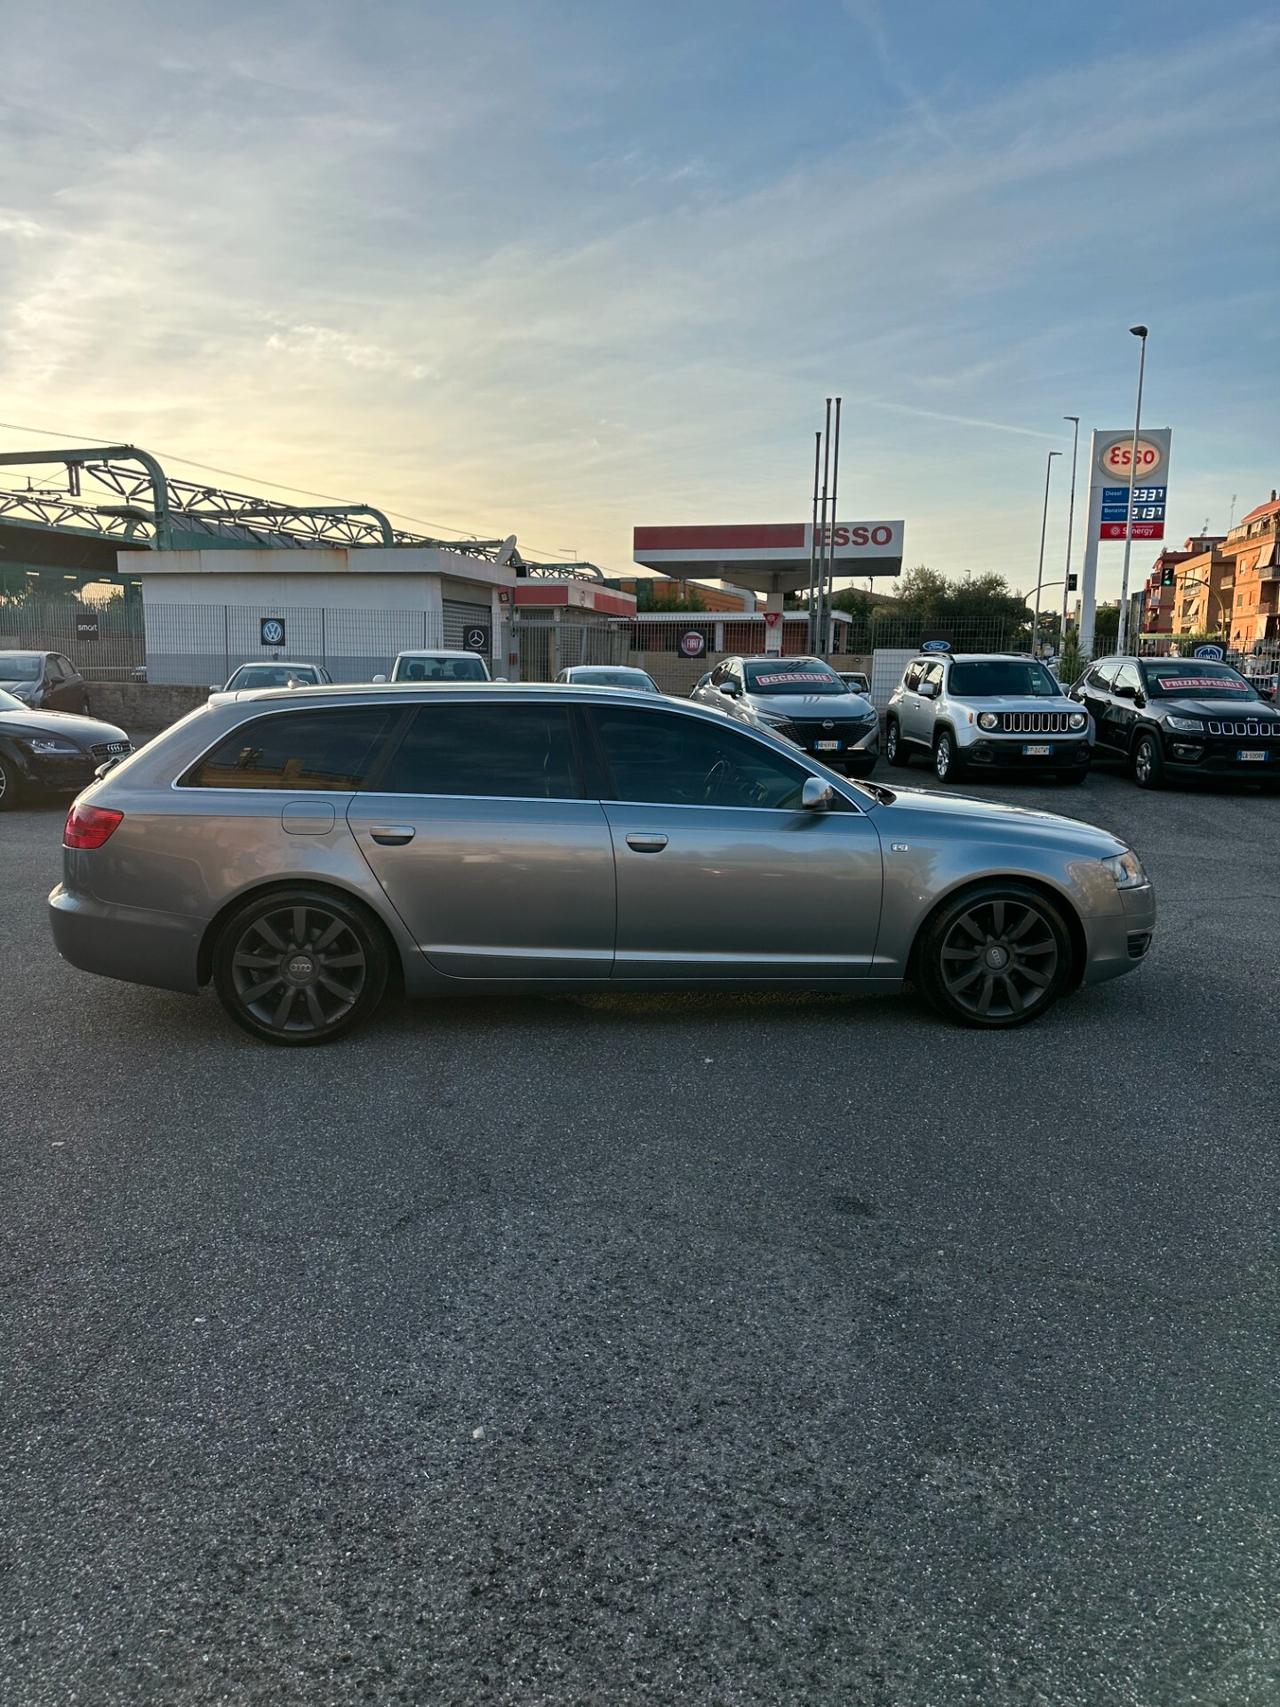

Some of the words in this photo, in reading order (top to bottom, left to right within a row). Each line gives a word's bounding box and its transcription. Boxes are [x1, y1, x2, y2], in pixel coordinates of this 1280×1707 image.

[1122, 526, 1154, 536] Snergy
[814, 526, 893, 547] ESSO
[686, 638, 700, 649] FIAT
[761, 674, 829, 683] OCCASIONE
[1164, 679, 1199, 688] PREZZO
[1200, 679, 1243, 689] SPECIALE
